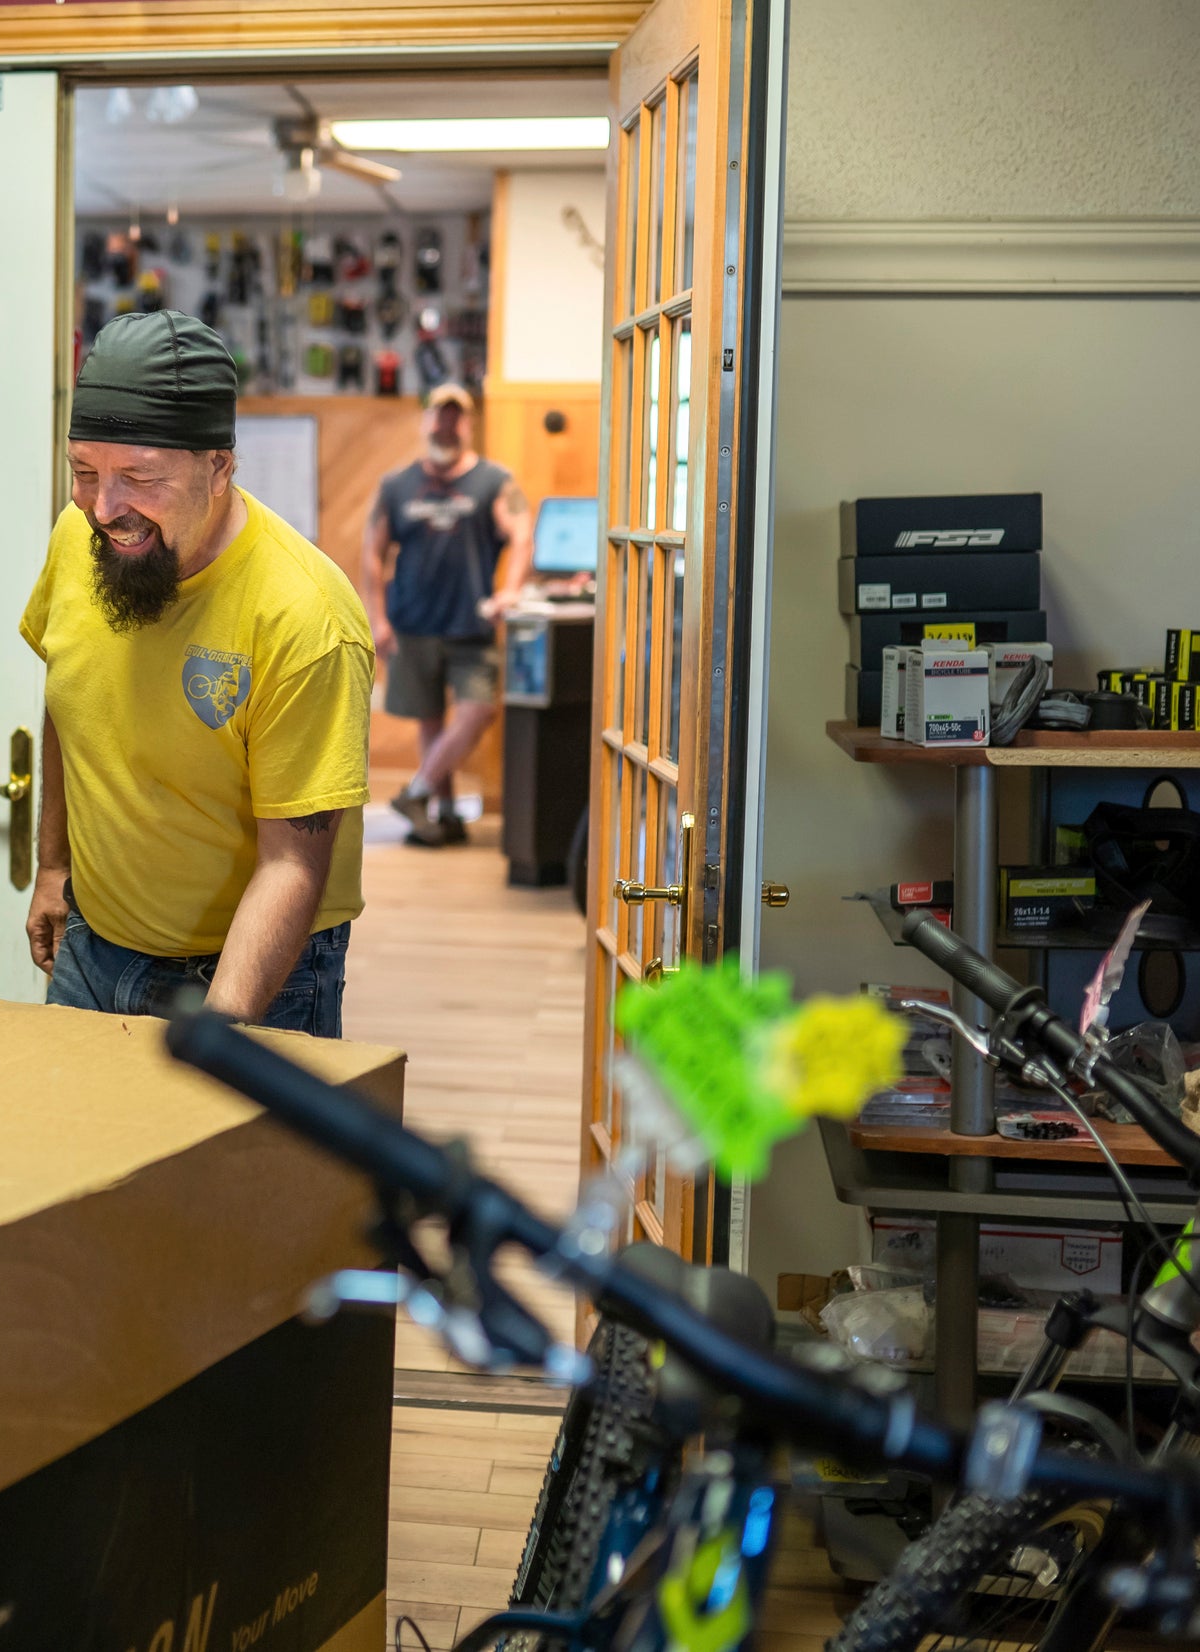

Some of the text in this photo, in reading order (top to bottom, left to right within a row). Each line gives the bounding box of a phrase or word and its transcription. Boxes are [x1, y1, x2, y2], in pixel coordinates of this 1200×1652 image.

[895, 528, 1005, 548] FSA
[186, 645, 208, 659] EVIL
[928, 723, 962, 732] 700x45-50c
[232, 1609, 271, 1652] Your
[272, 1571, 318, 1627] Move
